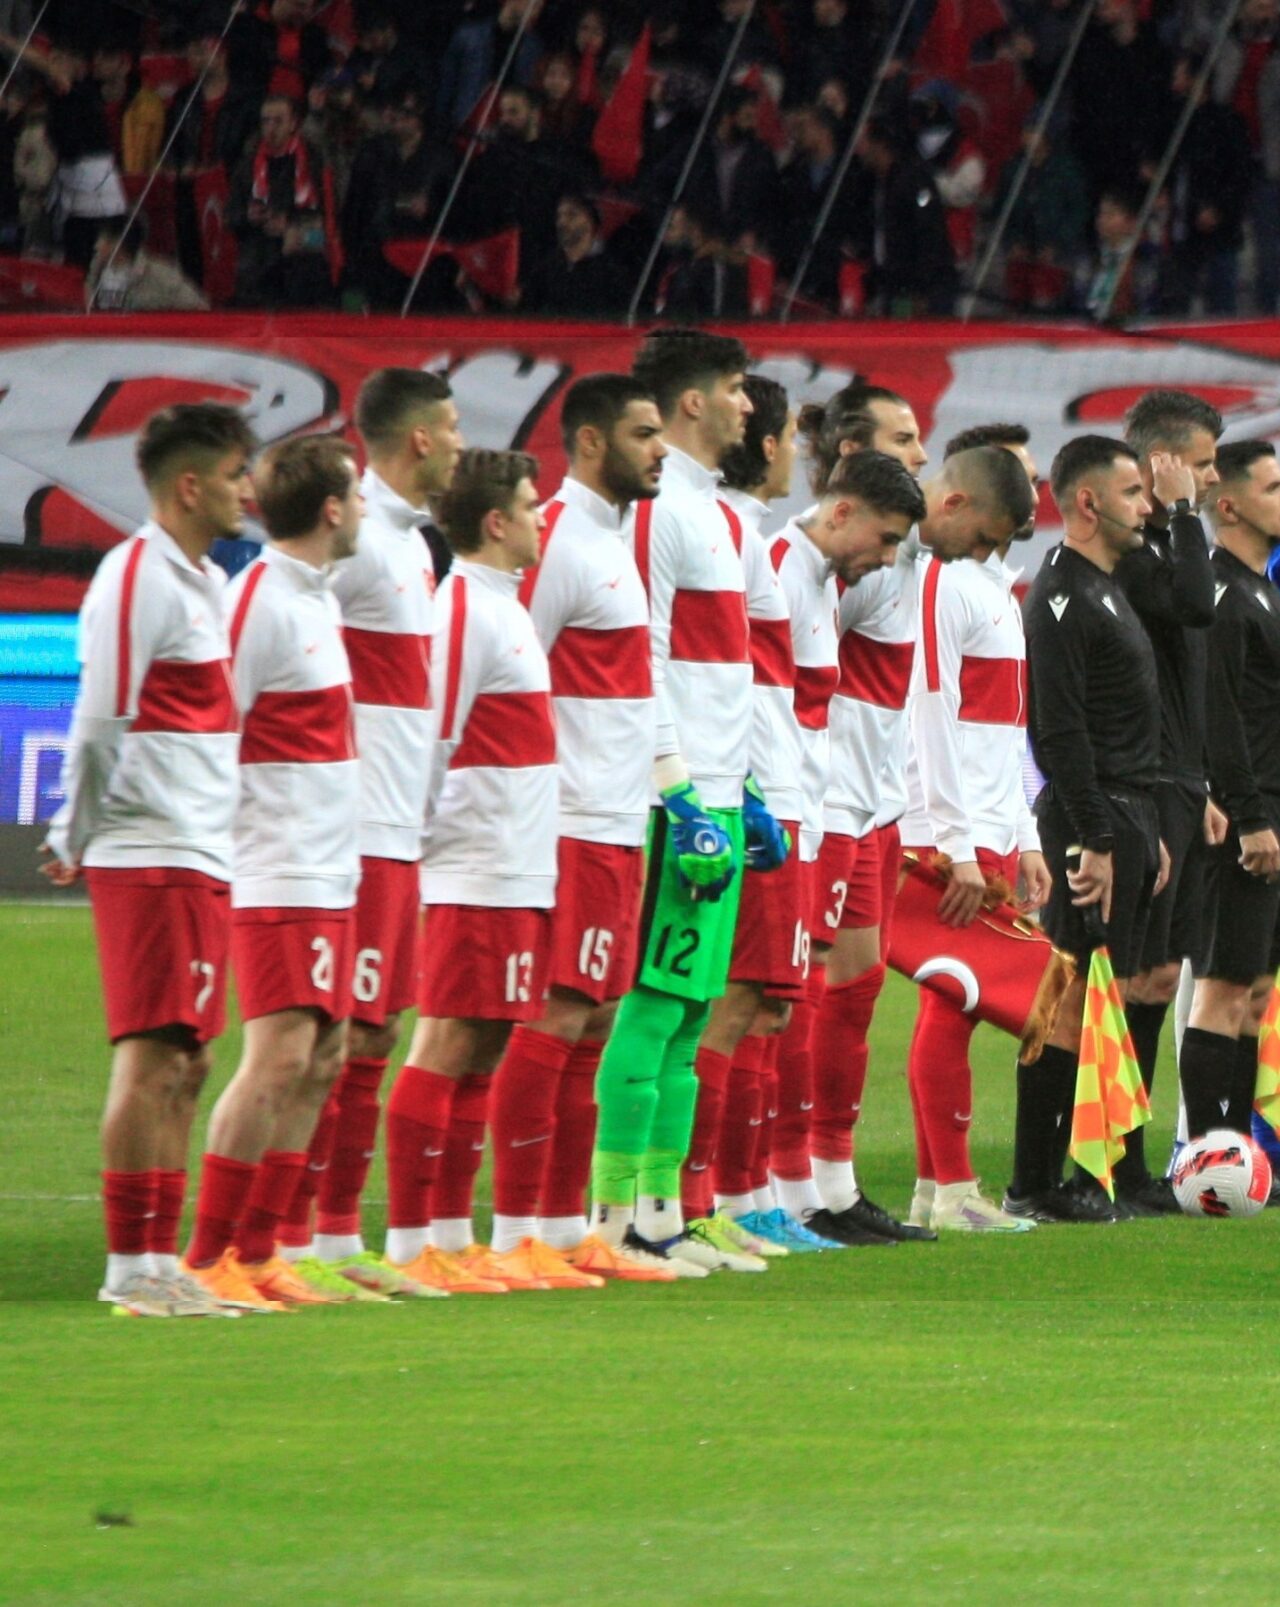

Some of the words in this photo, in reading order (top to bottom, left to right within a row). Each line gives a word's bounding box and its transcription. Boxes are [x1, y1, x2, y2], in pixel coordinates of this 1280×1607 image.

[824, 879, 848, 929] 3
[352, 947, 383, 1003] 6
[505, 950, 534, 1003] 13
[579, 926, 614, 982] 15
[653, 924, 701, 979] 12
